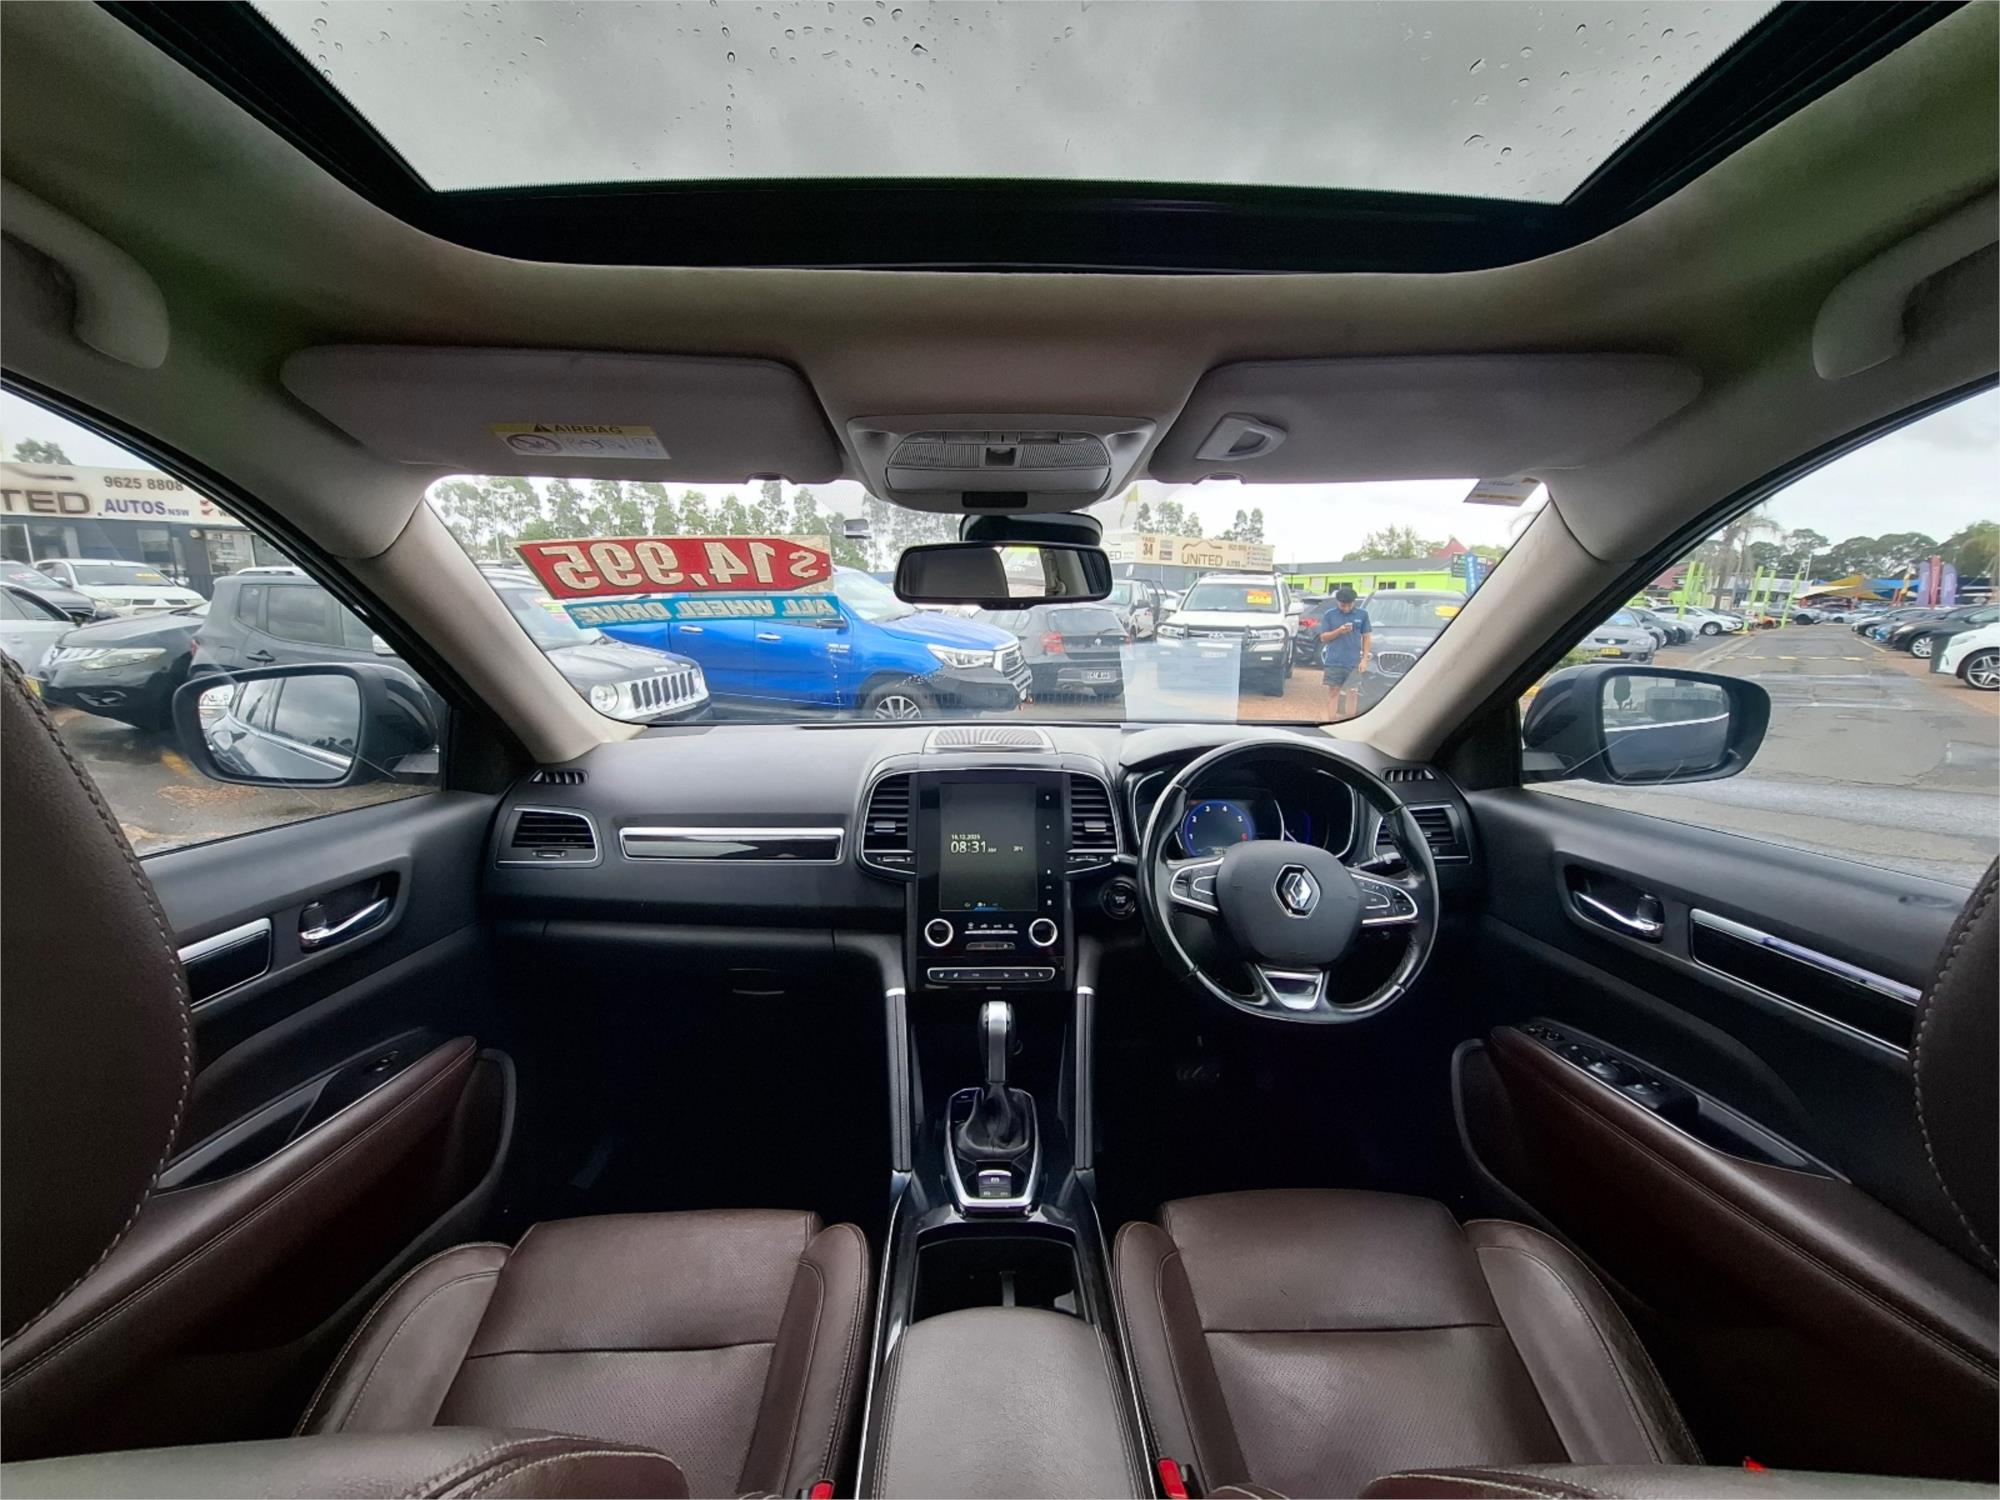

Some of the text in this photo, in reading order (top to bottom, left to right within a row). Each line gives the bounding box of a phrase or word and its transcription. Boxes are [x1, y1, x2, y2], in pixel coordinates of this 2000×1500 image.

[554, 424, 623, 434] AIRBAG
[104, 476, 184, 491] 9625 8808
[105, 499, 189, 516] AUTOS NSW
[1143, 543, 1154, 556] 34
[950, 841, 986, 853] 08:31
